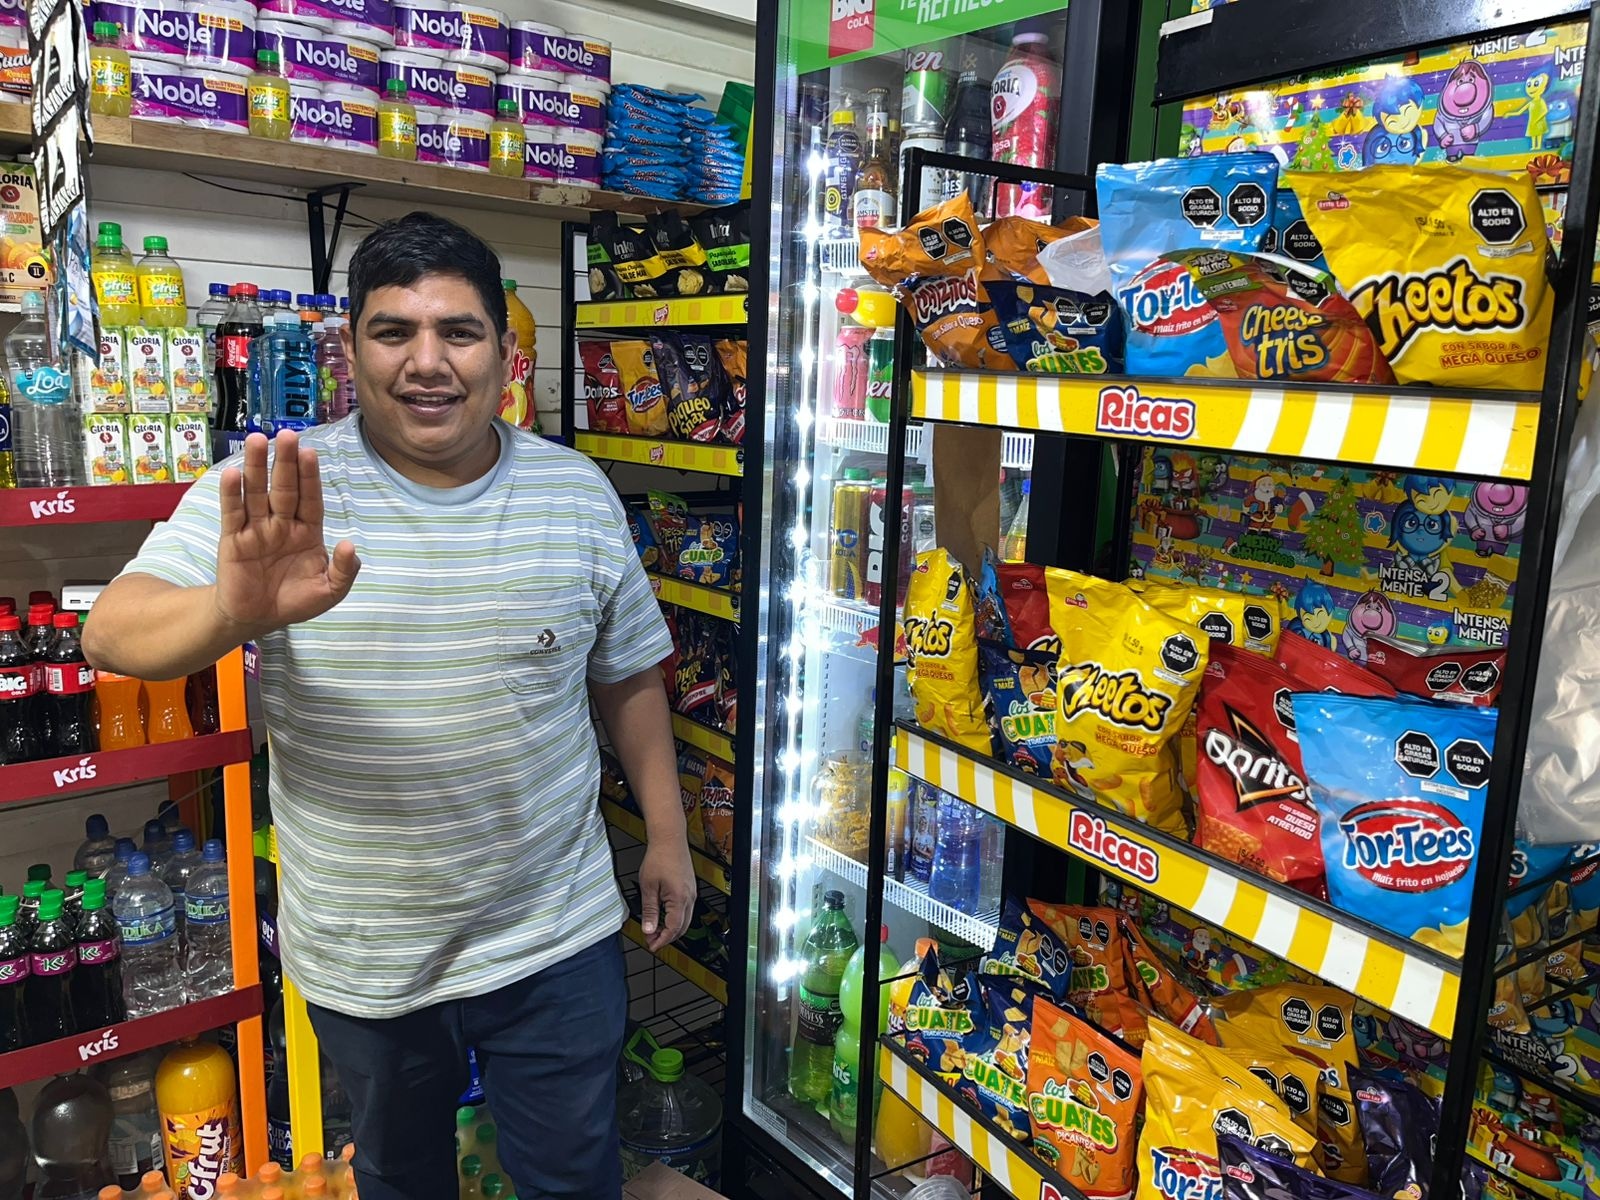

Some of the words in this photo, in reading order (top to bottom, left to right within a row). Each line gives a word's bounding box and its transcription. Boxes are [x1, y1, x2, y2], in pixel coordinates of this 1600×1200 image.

[139, 9, 212, 44] Noble
[411, 10, 473, 39] Noble
[847, 15, 870, 30] COLA
[296, 40, 358, 74] Noble
[544, 36, 594, 66] Noble
[1473, 35, 1519, 59] MENTE
[1554, 46, 1587, 66] INTE
[145, 75, 217, 107] Noble
[411, 68, 467, 99] Noble
[290, 99, 353, 129] Noble
[529, 91, 580, 119] Noble
[526, 145, 575, 170] Noble
[1237, 205, 1259, 213] SODIO
[1477, 208, 1499, 217] ALTO
[1500, 207, 1514, 216] EN
[1481, 218, 1512, 227] SODIO
[1199, 252, 1229, 266] MUCHOS
[1199, 261, 1232, 276] PALITOS
[1209, 277, 1249, 293] CONTENIDO
[1175, 318, 1192, 333] frito
[1192, 318, 1202, 326] en
[1242, 305, 1323, 347] Cheese
[132, 337, 161, 347] GLORIA
[172, 337, 201, 347] GLORIA
[1441, 343, 1466, 351] CON
[1467, 343, 1506, 351] SABOR
[1258, 331, 1327, 379] tris
[1440, 352, 1482, 369] MEGA
[1484, 346, 1541, 365] QUESO
[27, 372, 68, 396] Loa
[667, 396, 712, 437] Piqueo
[1100, 388, 1193, 437] Ricas
[90, 424, 120, 435] GLORIA
[133, 424, 163, 434] GLORIA
[175, 423, 204, 434] GLORIA
[680, 412, 708, 437] Snax
[30, 491, 76, 519] Kris
[900, 503, 910, 544] COLA
[1379, 563, 1429, 583] INTENSA
[1382, 581, 1423, 598] MENTE
[1429, 572, 1451, 602] 2
[1204, 624, 1219, 632] ALTO
[1454, 608, 1509, 631] INTENSA
[1459, 627, 1504, 646] MENTE
[529, 645, 562, 656] CONVERSE
[1169, 643, 1183, 656] ALTO
[1181, 649, 1194, 660] EN
[1169, 650, 1189, 664] SODIO
[1061, 664, 1172, 731] Cheetos
[1009, 701, 1031, 716] los
[1003, 717, 1056, 741] CUAT
[1113, 730, 1144, 743] SABOR
[1095, 732, 1121, 750] MEGA
[1120, 740, 1158, 756] QUESO
[1403, 743, 1420, 752] ALTO
[1420, 745, 1432, 753] EN
[1403, 748, 1433, 760] GRASAS
[1398, 755, 1438, 768] SATURADAS
[1452, 754, 1471, 764] ALTO
[1472, 757, 1485, 766] EN
[1456, 763, 1481, 774] SODIO
[53, 757, 97, 788] Kris
[1279, 803, 1292, 813] CON
[1290, 809, 1313, 823] SABOR
[1285, 814, 1316, 833] QUESO
[1266, 815, 1313, 841] ATREVIDO
[1072, 813, 1155, 877] Ricas
[1341, 821, 1474, 869] Tor-Tees
[1395, 876, 1419, 888] frito
[1420, 876, 1433, 886] en
[1434, 862, 1466, 883] hojuelas
[261, 921, 275, 942] OLT
[1286, 1012, 1308, 1020] GRASAS
[1287, 1006, 1299, 1014] ALTO
[1322, 1022, 1337, 1030] SODIO
[78, 1030, 119, 1062] Kris
[1495, 1029, 1552, 1062] INTENSA
[1554, 1054, 1579, 1083] 2
[1045, 1080, 1067, 1098] los
[1031, 1096, 1116, 1146] CUATES
[187, 1123, 223, 1200] Cifrut
